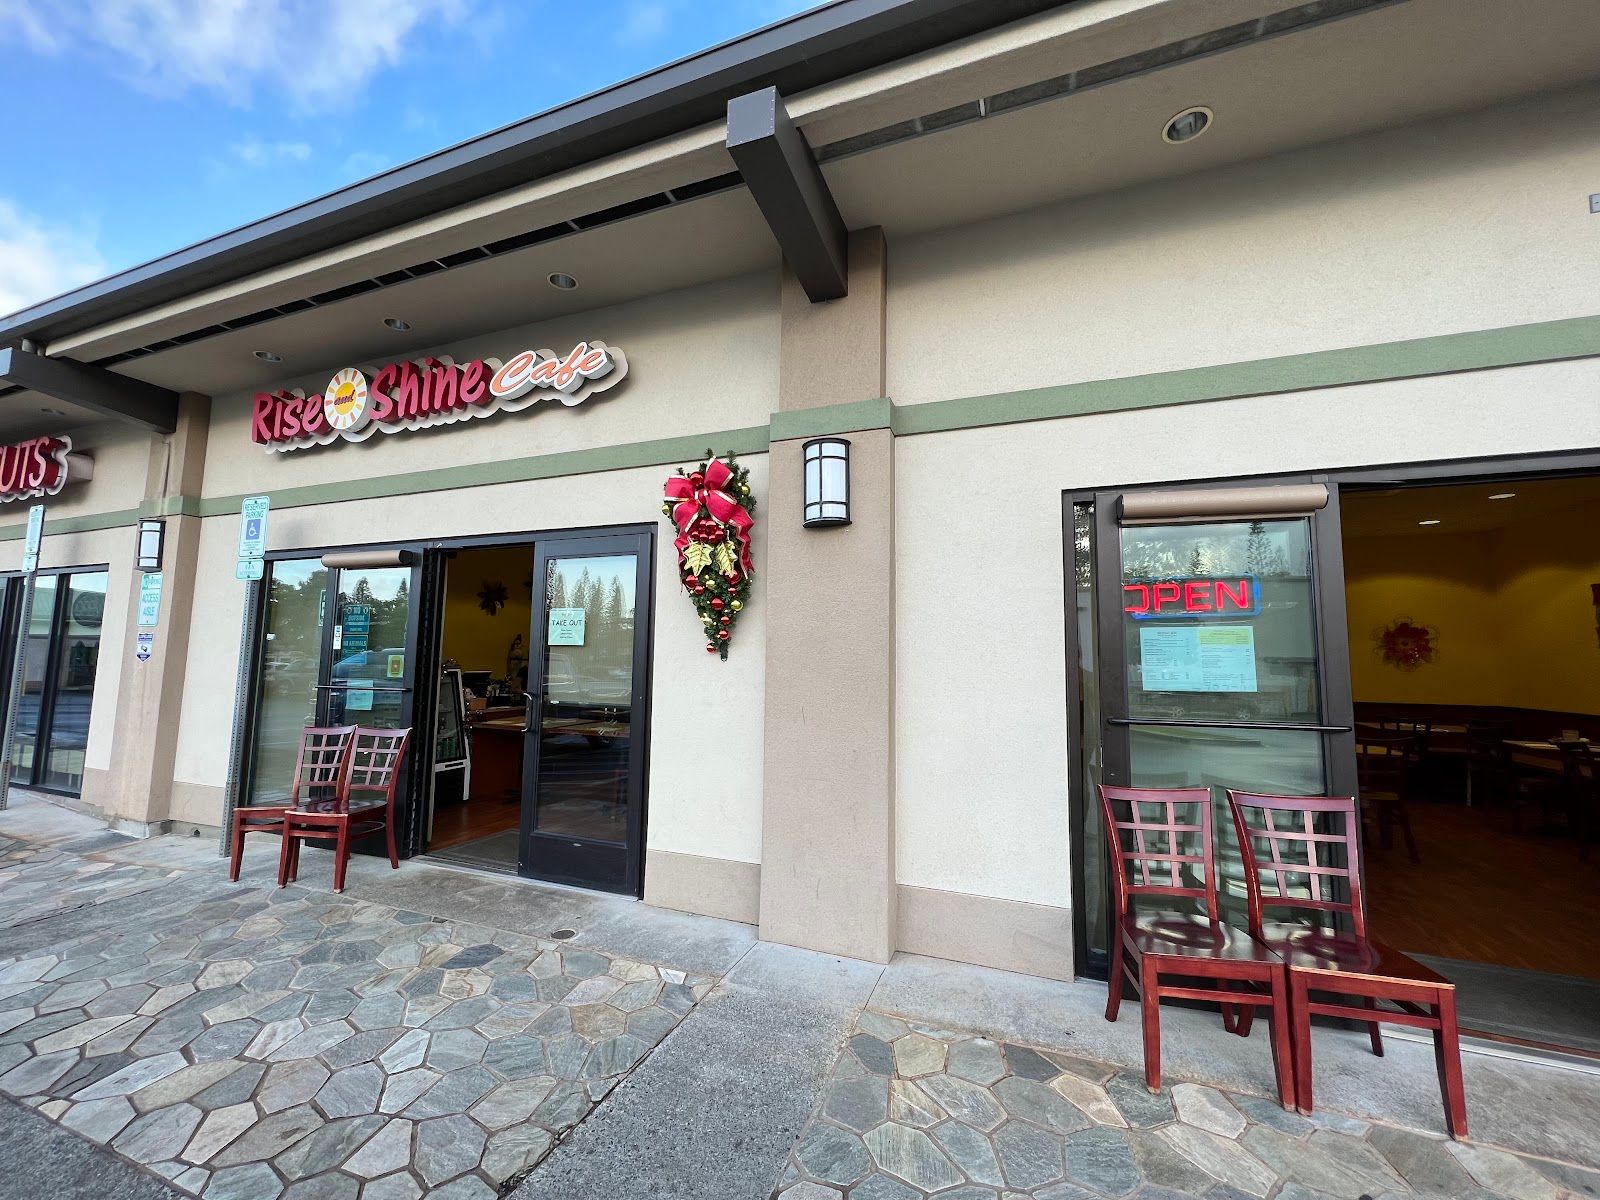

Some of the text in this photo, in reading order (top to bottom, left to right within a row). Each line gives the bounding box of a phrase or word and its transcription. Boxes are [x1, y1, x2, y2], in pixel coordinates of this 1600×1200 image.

[252, 341, 608, 443] Rise and Shine Cafe
[0, 436, 50, 493] UTS
[245, 502, 266, 511] RESERVED
[245, 511, 264, 519] PARKING
[142, 593, 159, 603] ACCESS
[1124, 580, 1249, 613] OPEN
[143, 606, 156, 616] AISLE
[353, 606, 361, 614] NO
